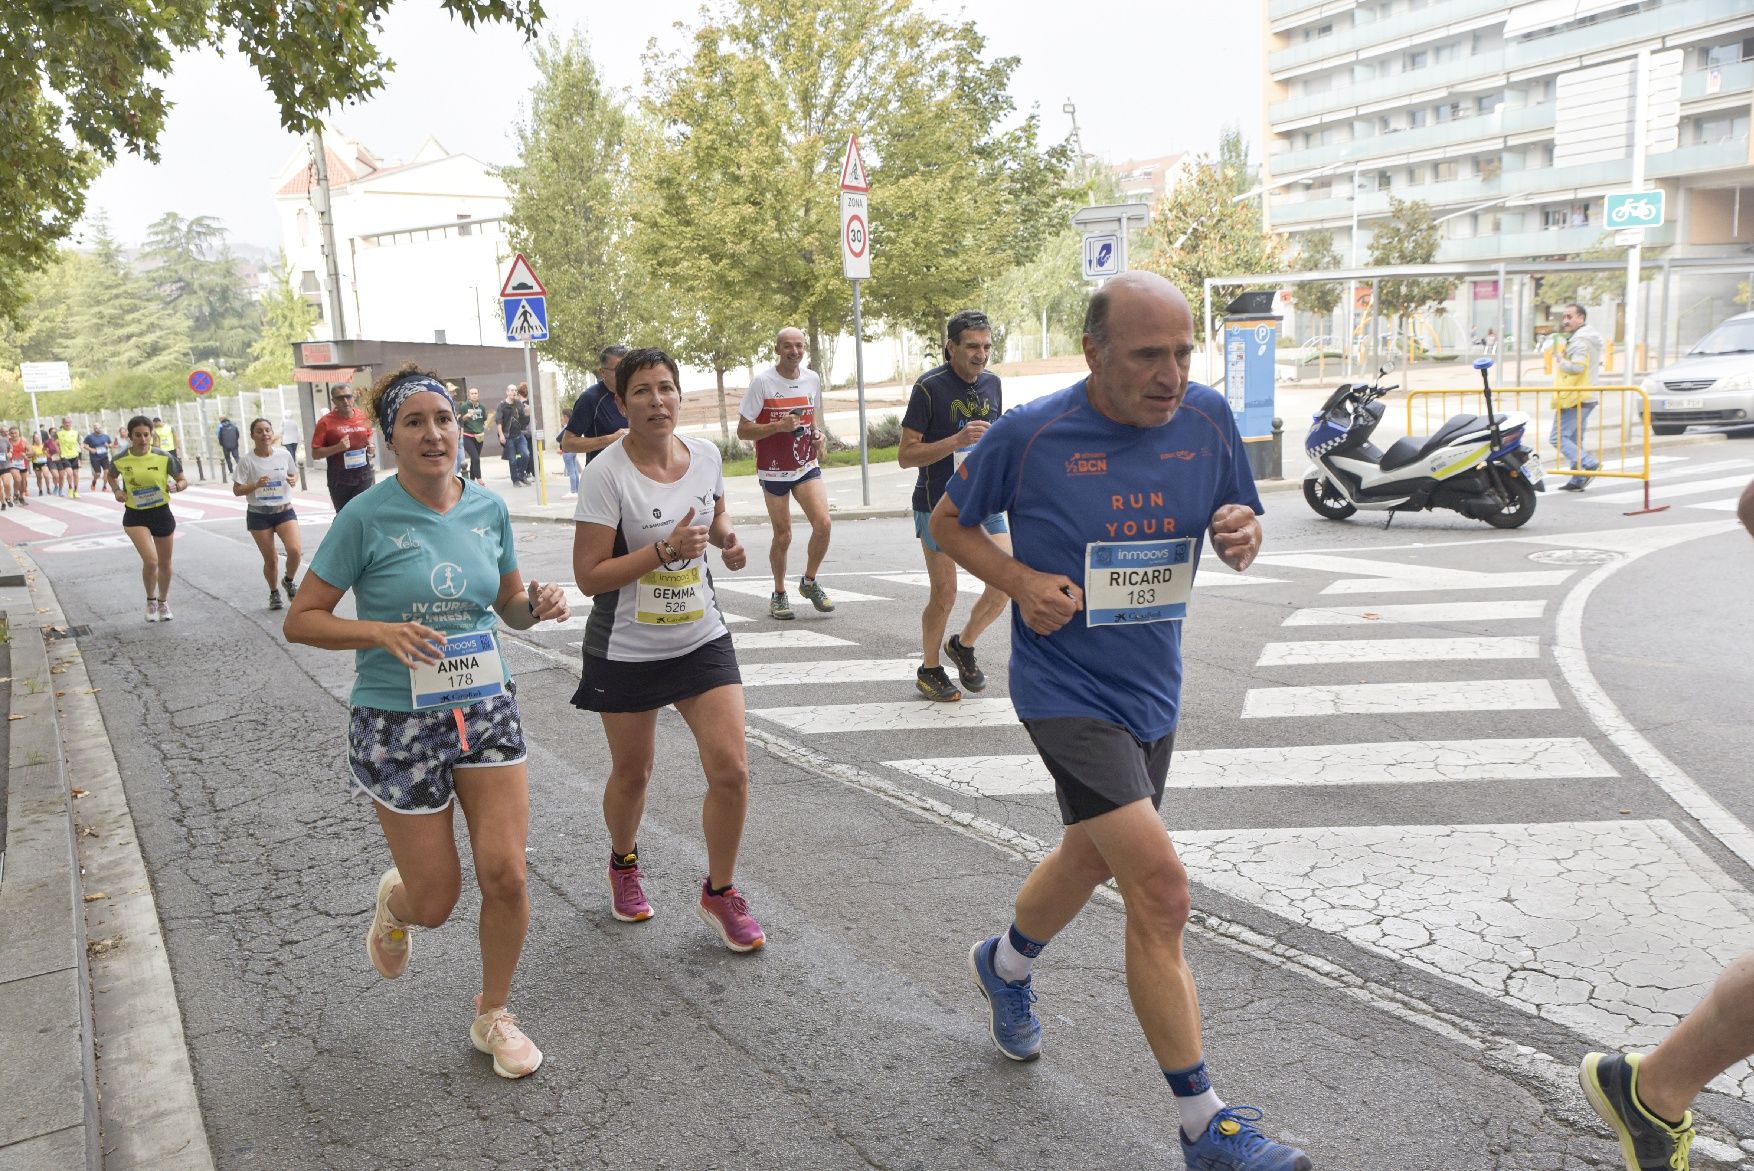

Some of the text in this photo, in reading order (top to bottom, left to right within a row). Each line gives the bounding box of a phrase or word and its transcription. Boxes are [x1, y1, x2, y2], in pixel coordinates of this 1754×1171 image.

[847, 197, 863, 208] ZONA
[850, 229, 862, 242] 30
[1078, 459, 1107, 472] BCN
[1112, 491, 1164, 510] RUN
[1106, 518, 1176, 537] YOUR
[1117, 548, 1169, 560] inmoovs
[1109, 568, 1172, 587] RICARD
[653, 587, 695, 600] GEMMA
[1127, 588, 1156, 605] 183
[412, 602, 428, 613] IV
[665, 601, 686, 613] 526
[437, 656, 480, 674] ANNA
[448, 673, 474, 688] 178
